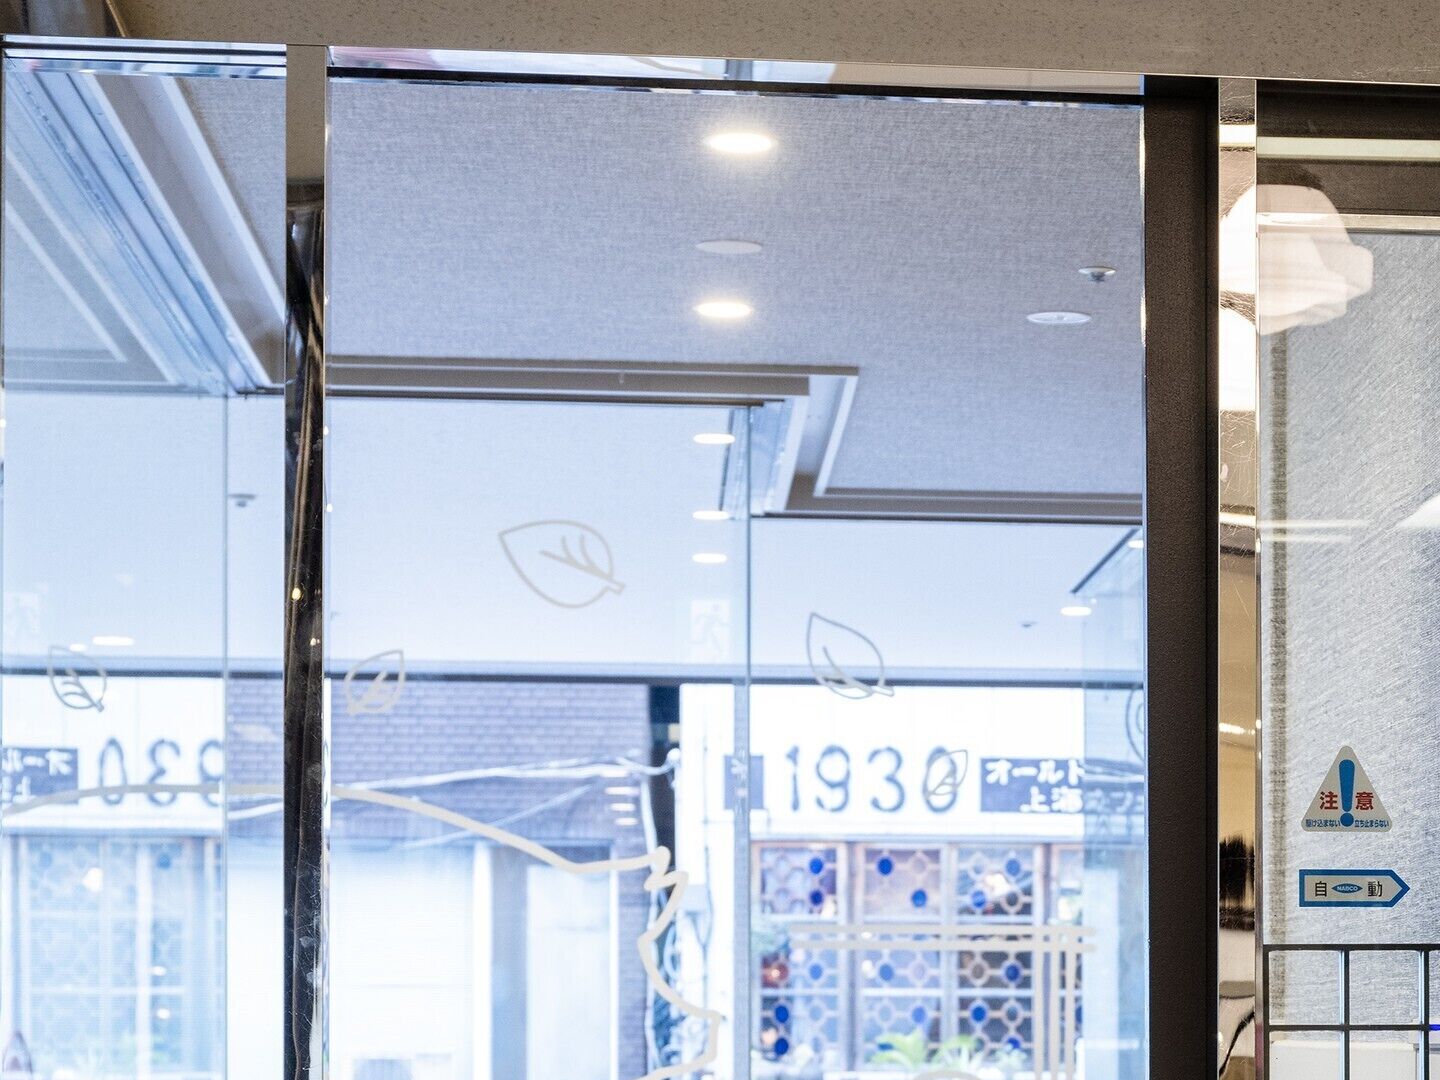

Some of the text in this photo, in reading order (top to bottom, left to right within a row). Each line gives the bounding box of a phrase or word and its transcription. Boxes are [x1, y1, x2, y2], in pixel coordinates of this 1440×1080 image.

[785, 745, 958, 813] 1930
[1354, 818, 1389, 828] 立ち止まらない
